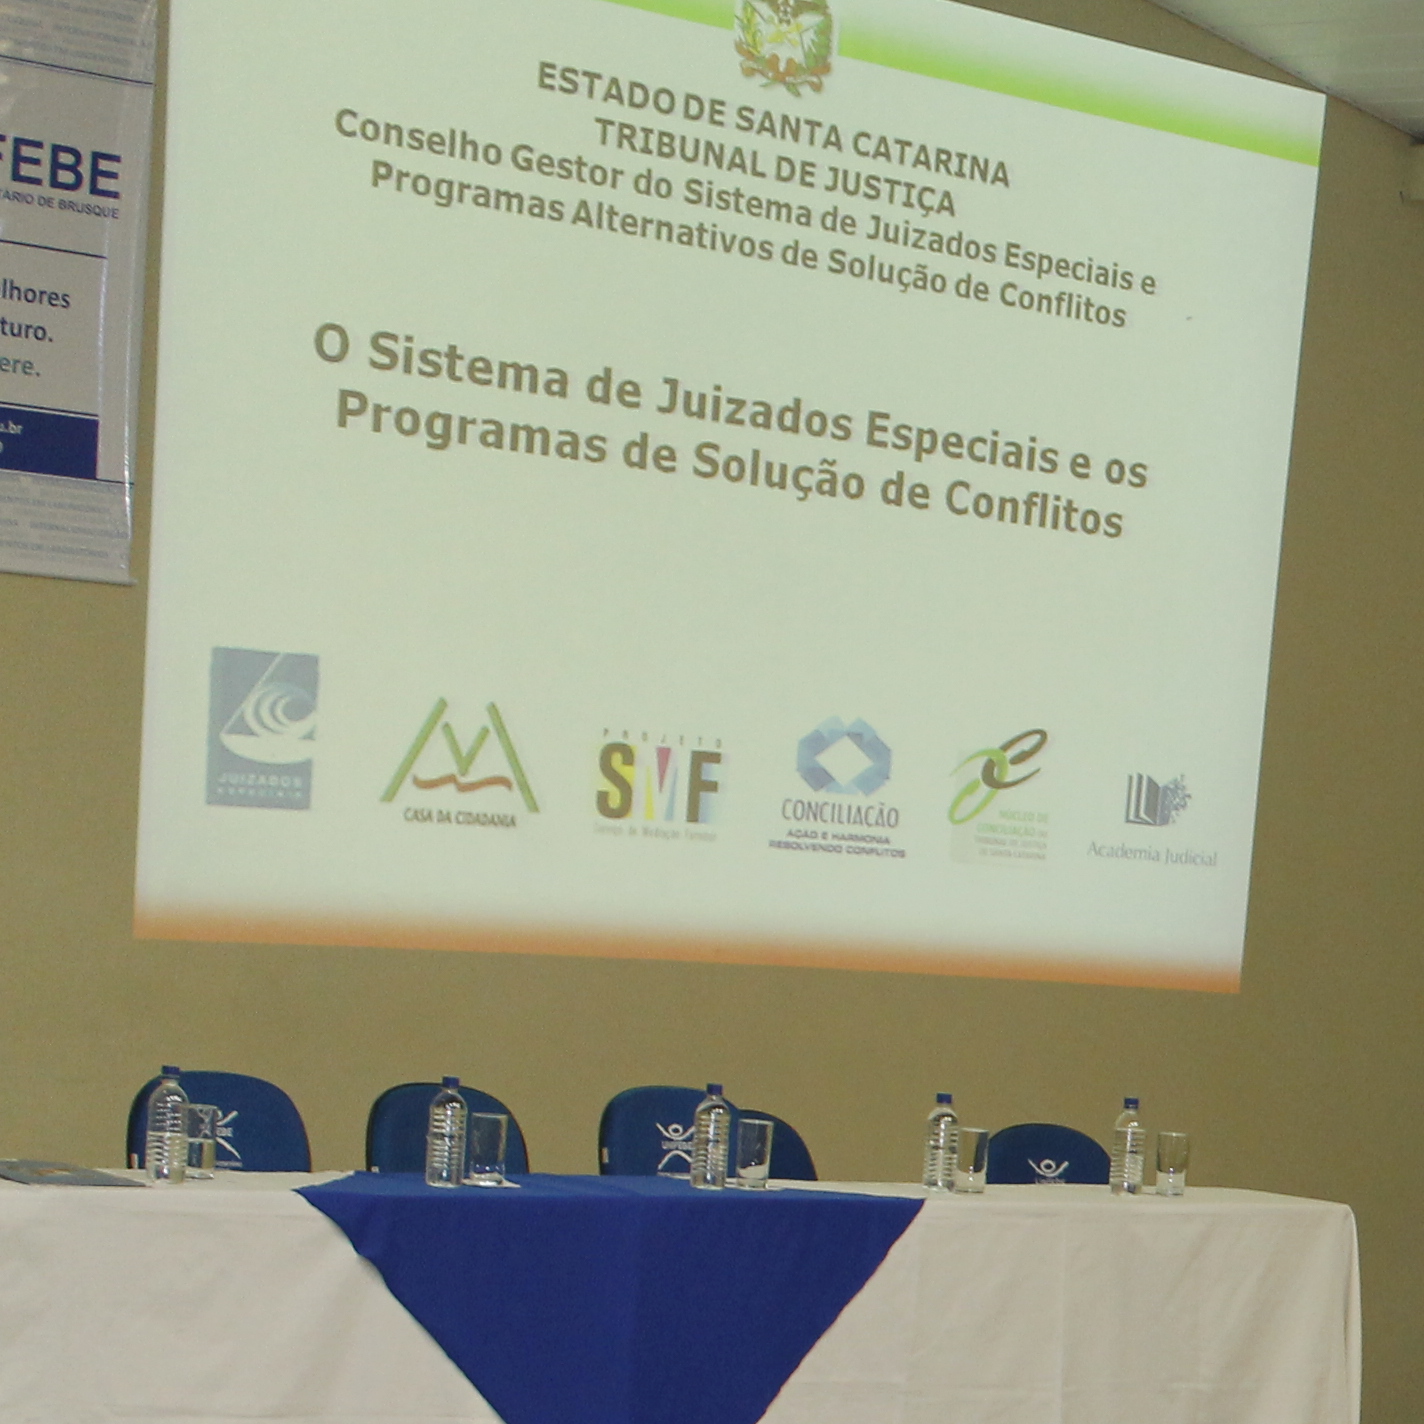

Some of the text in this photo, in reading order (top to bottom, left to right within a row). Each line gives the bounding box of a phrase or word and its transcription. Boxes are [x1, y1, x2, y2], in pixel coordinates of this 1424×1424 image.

[537, 60, 1010, 188] ESTADO DE SANTA CATARINA
[0, 133, 122, 199] EBE
[38, 194, 54, 209] DE
[58, 198, 120, 220] BRUSQUE
[335, 108, 1157, 295] Conselho Gestor do Sistema de Juizados Especiais e
[595, 116, 956, 217] TRIBUNAL DE JUSTIÇA
[371, 159, 1127, 328] Programas Alternativos de Solução de Conflitos
[0, 278, 70, 309] lhores
[314, 322, 1149, 489] O Sistema de Juizados Especiais e os
[337, 388, 1124, 538] Programas de Solução de Conflitos
[404, 807, 433, 822] CASA
[437, 809, 452, 823] DA
[782, 798, 900, 828] CONCILIAÇÃO
[1087, 841, 1218, 867] Academia Judicial
